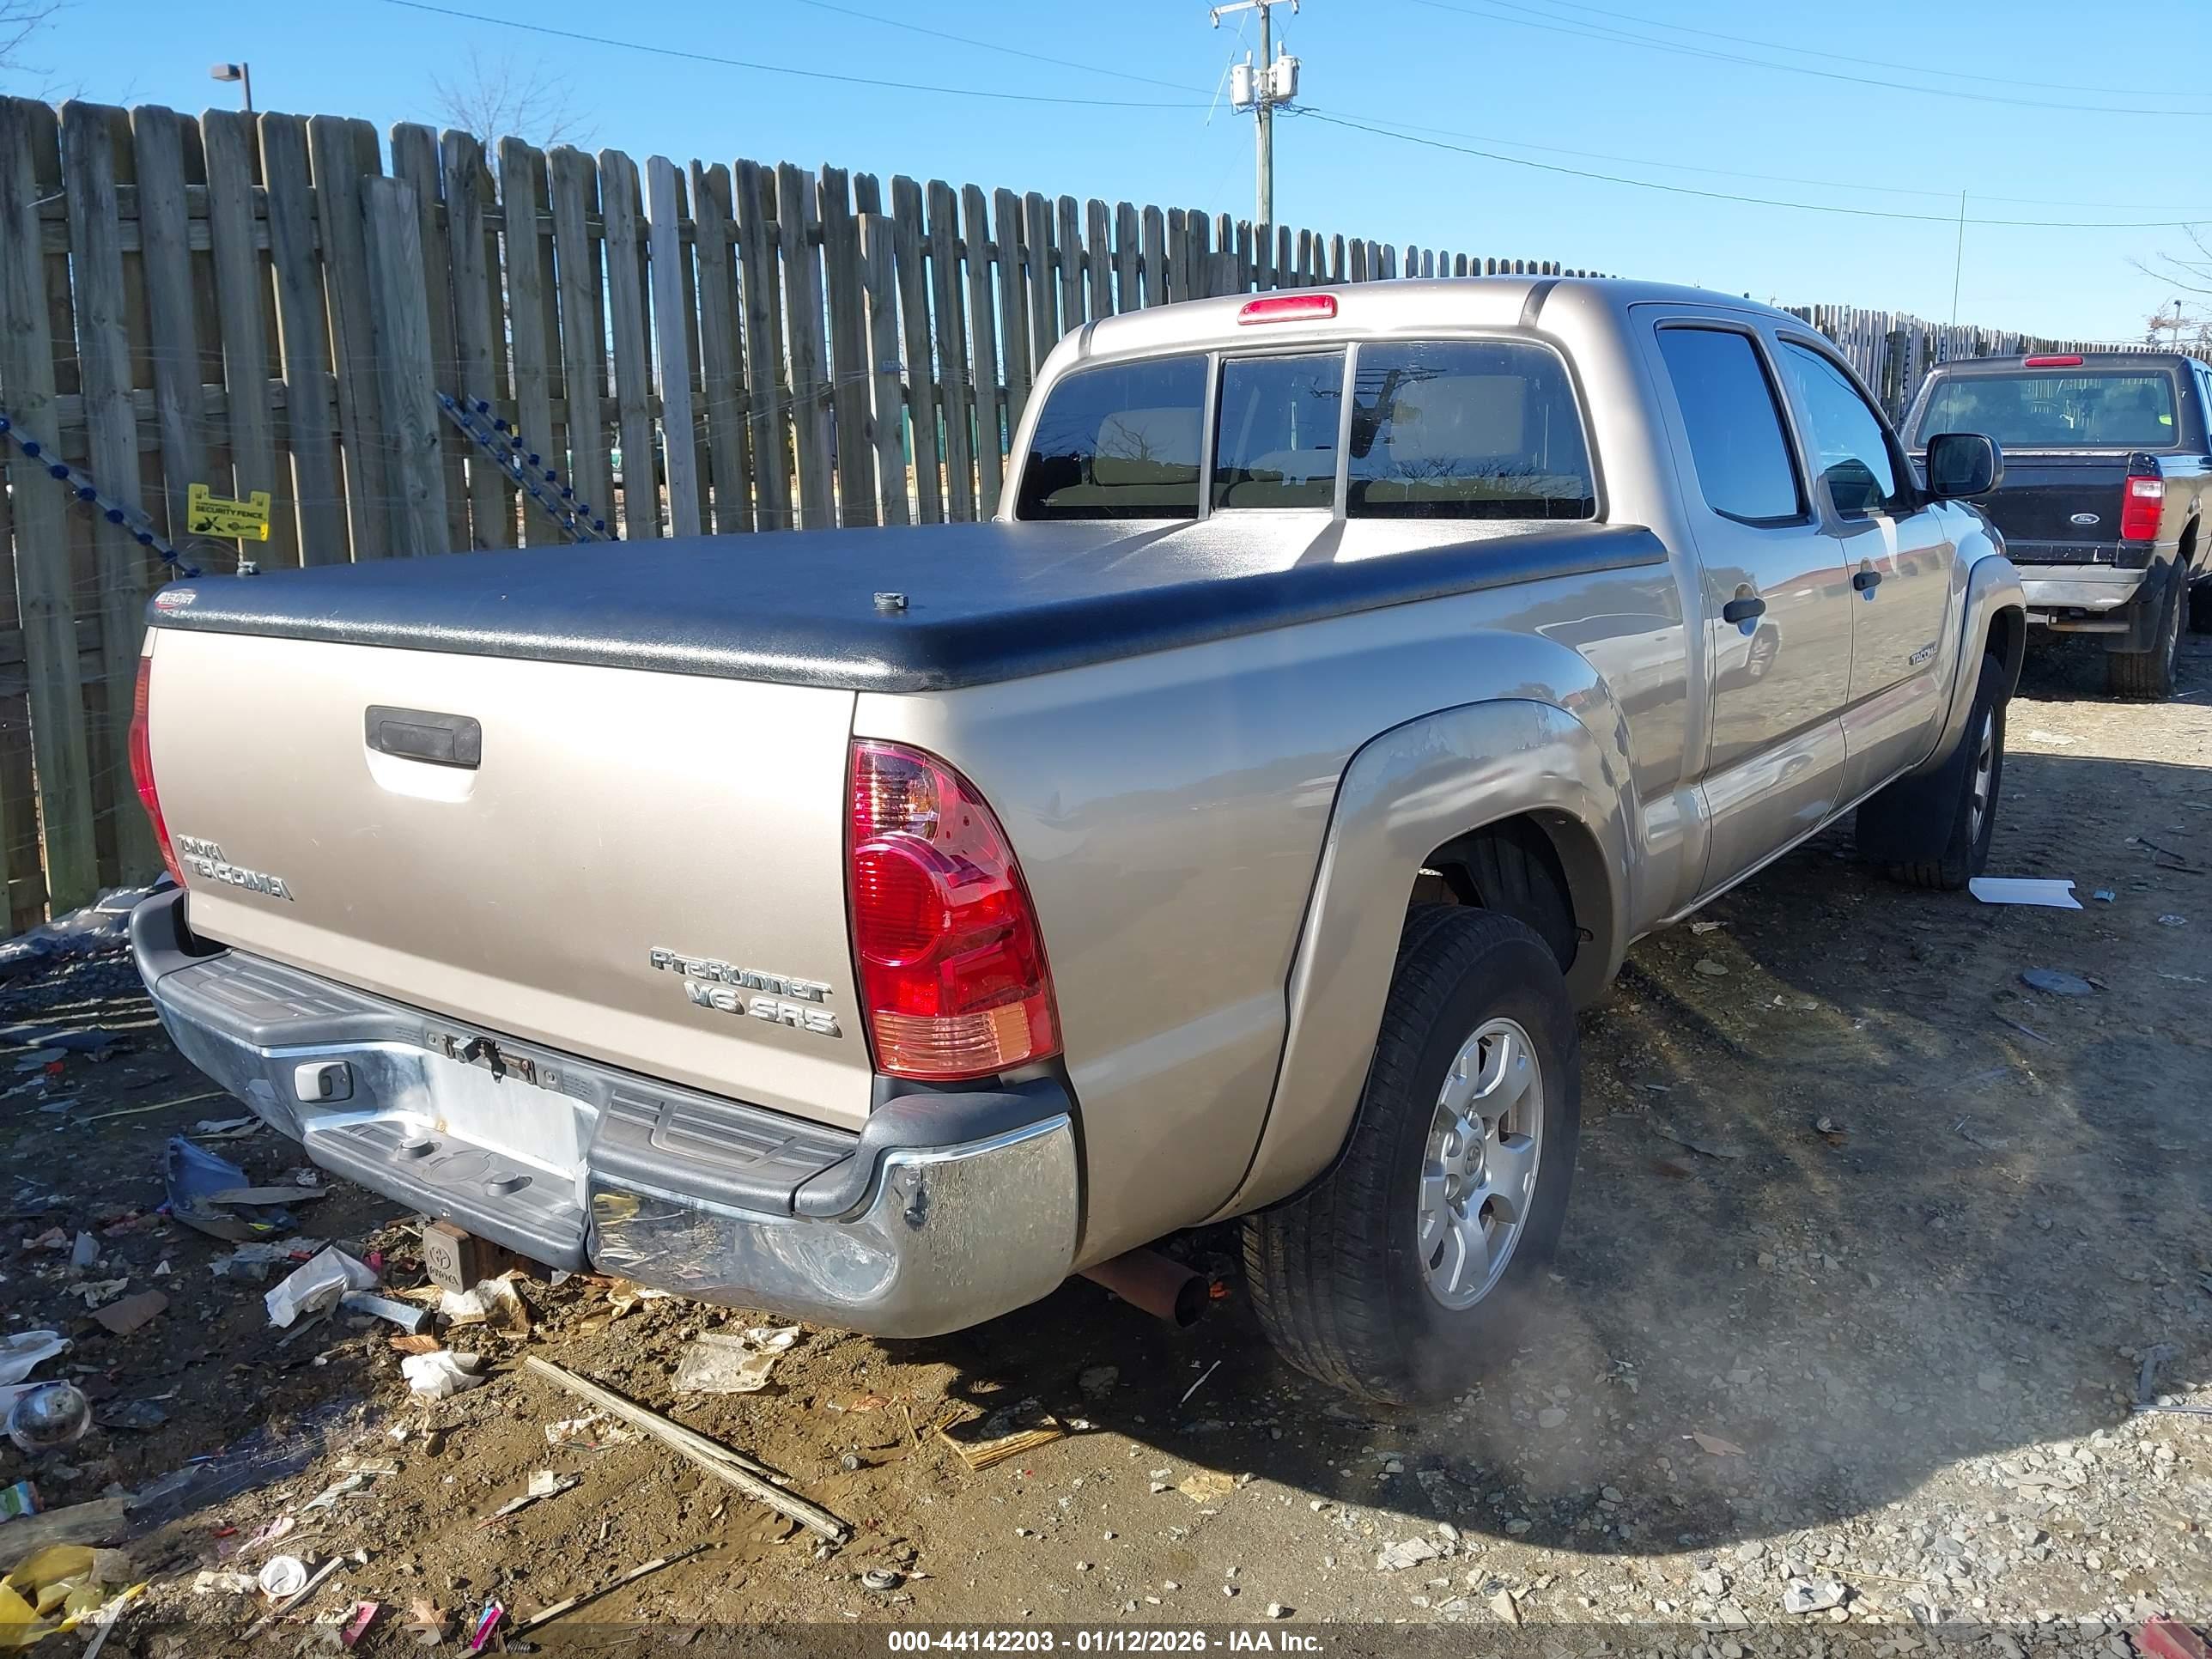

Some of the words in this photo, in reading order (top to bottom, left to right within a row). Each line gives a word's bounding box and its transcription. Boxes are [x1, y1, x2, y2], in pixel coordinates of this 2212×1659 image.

[195, 505, 238, 516] SECURITY
[237, 509, 264, 520] FENCE
[183, 854, 295, 902] TACOMA
[684, 981, 744, 1015] V6
